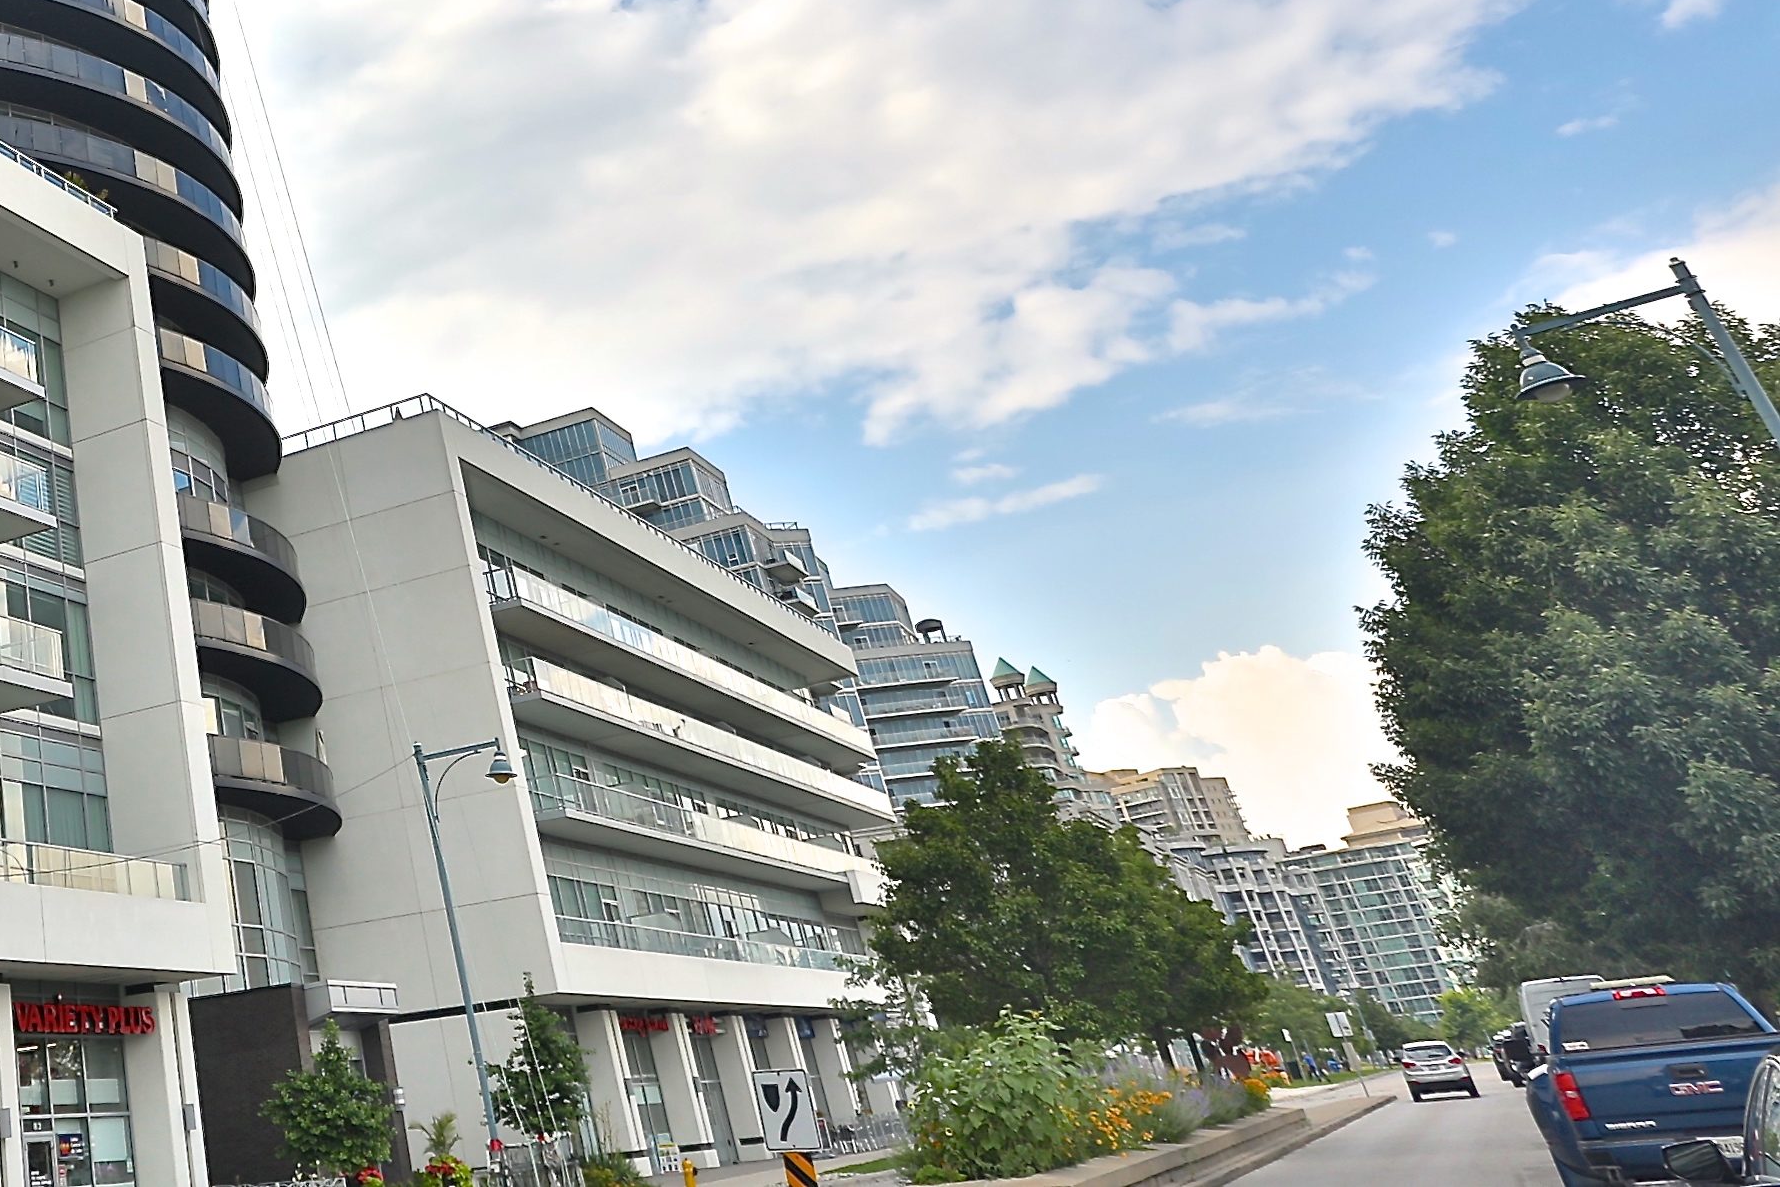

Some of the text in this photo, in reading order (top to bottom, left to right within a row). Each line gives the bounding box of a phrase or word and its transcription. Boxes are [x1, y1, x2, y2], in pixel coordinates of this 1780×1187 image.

[13, 1002, 156, 1034] VARIETY PLUS
[1668, 1080, 1724, 1096] GMC
